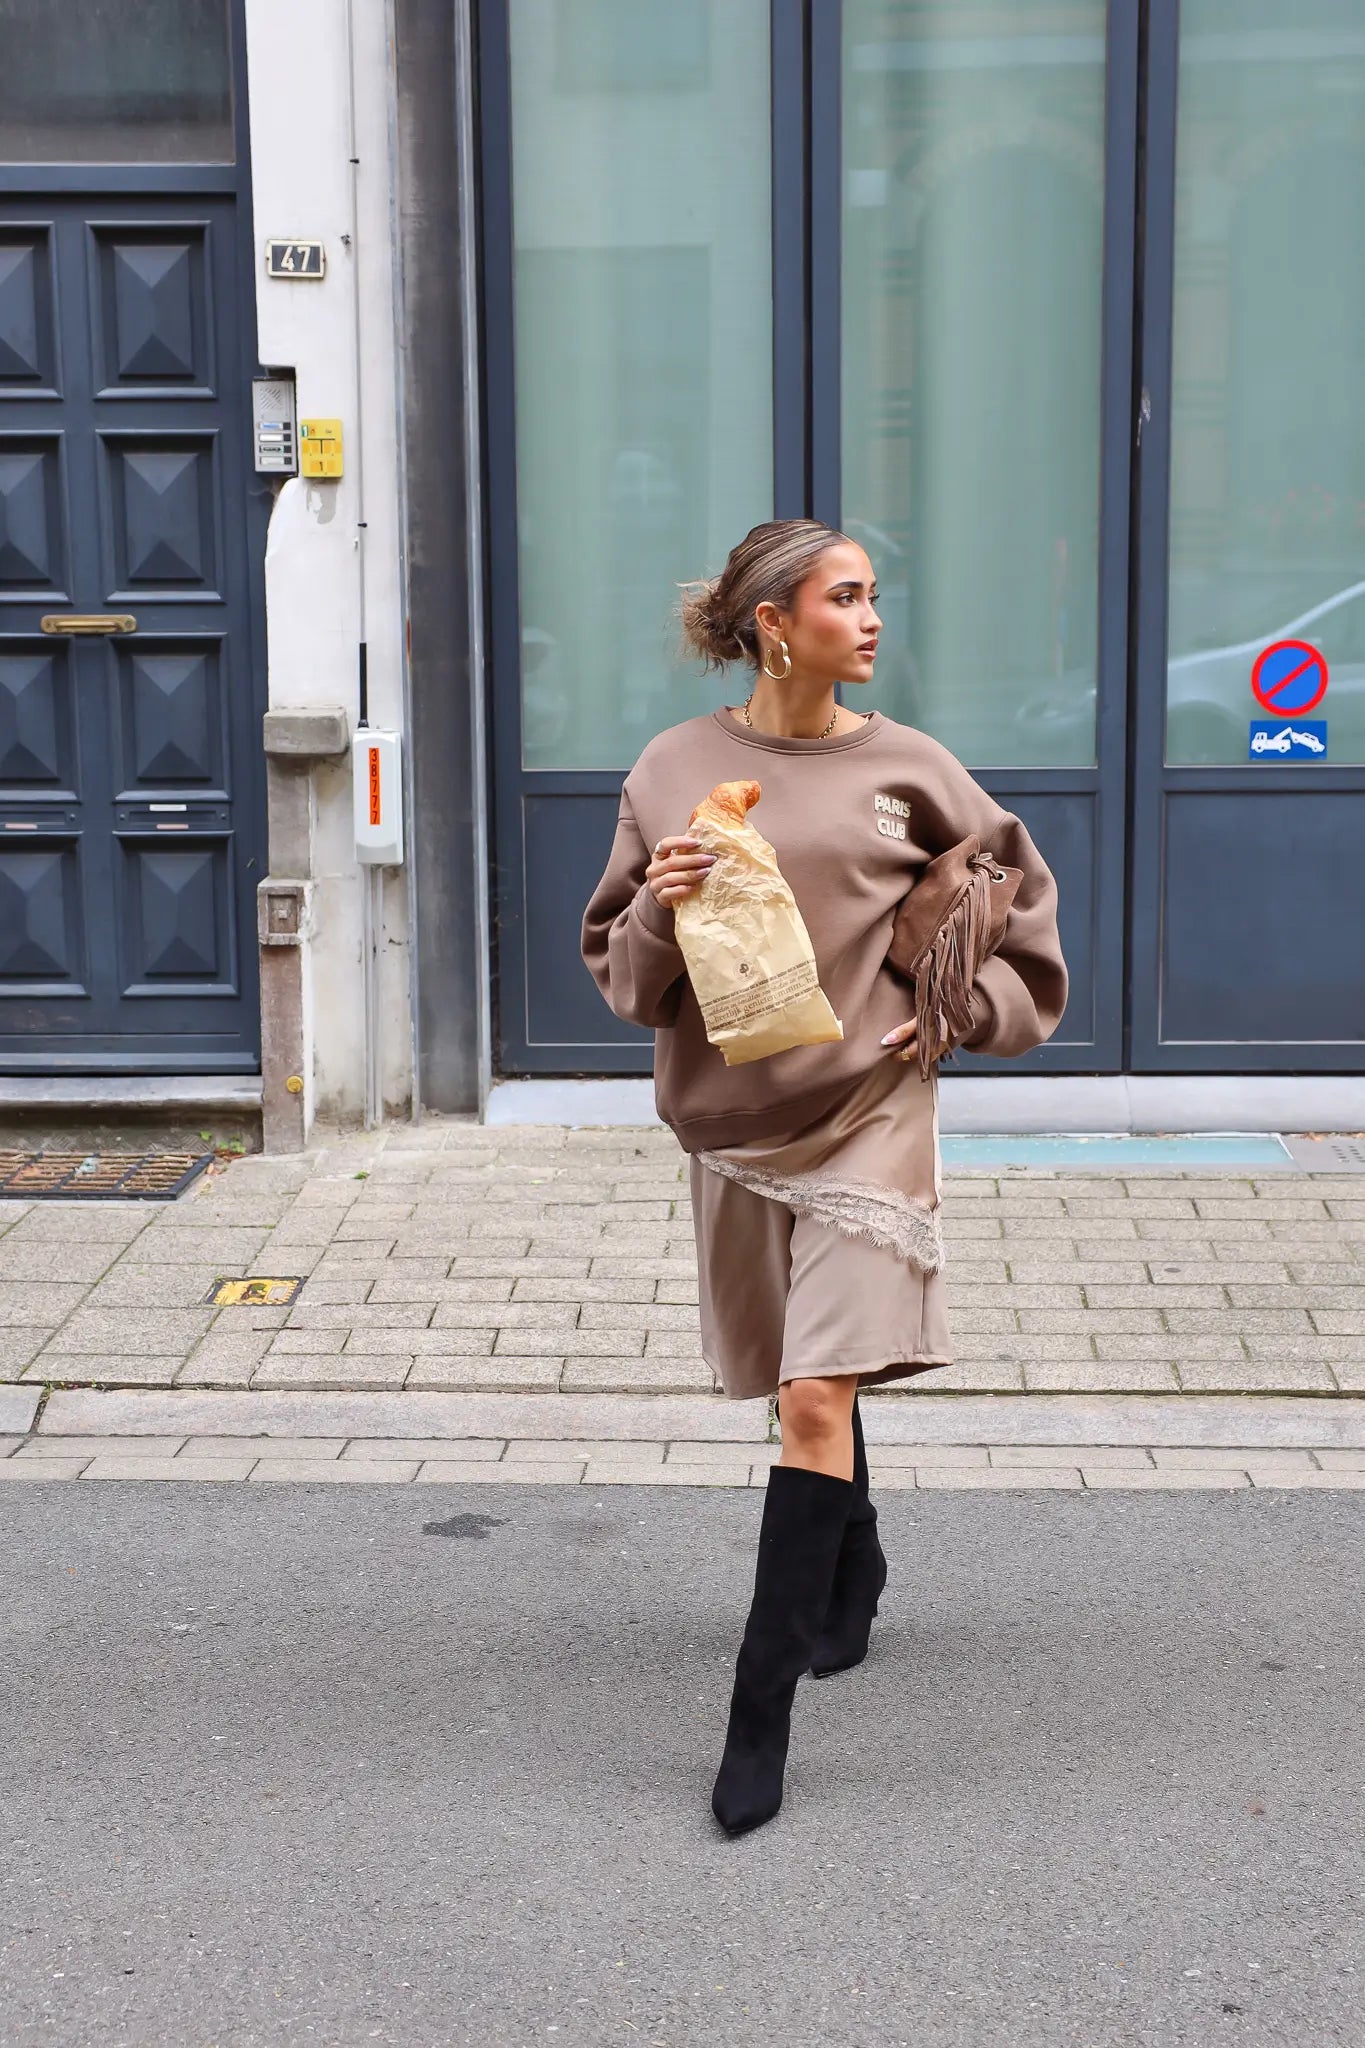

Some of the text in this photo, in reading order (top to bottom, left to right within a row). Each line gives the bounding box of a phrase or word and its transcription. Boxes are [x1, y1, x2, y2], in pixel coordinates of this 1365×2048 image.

[281, 245, 311, 271] 47
[371, 748, 379, 825] 38777
[874, 794, 911, 818] PARIS
[877, 818, 906, 840] CLUB
